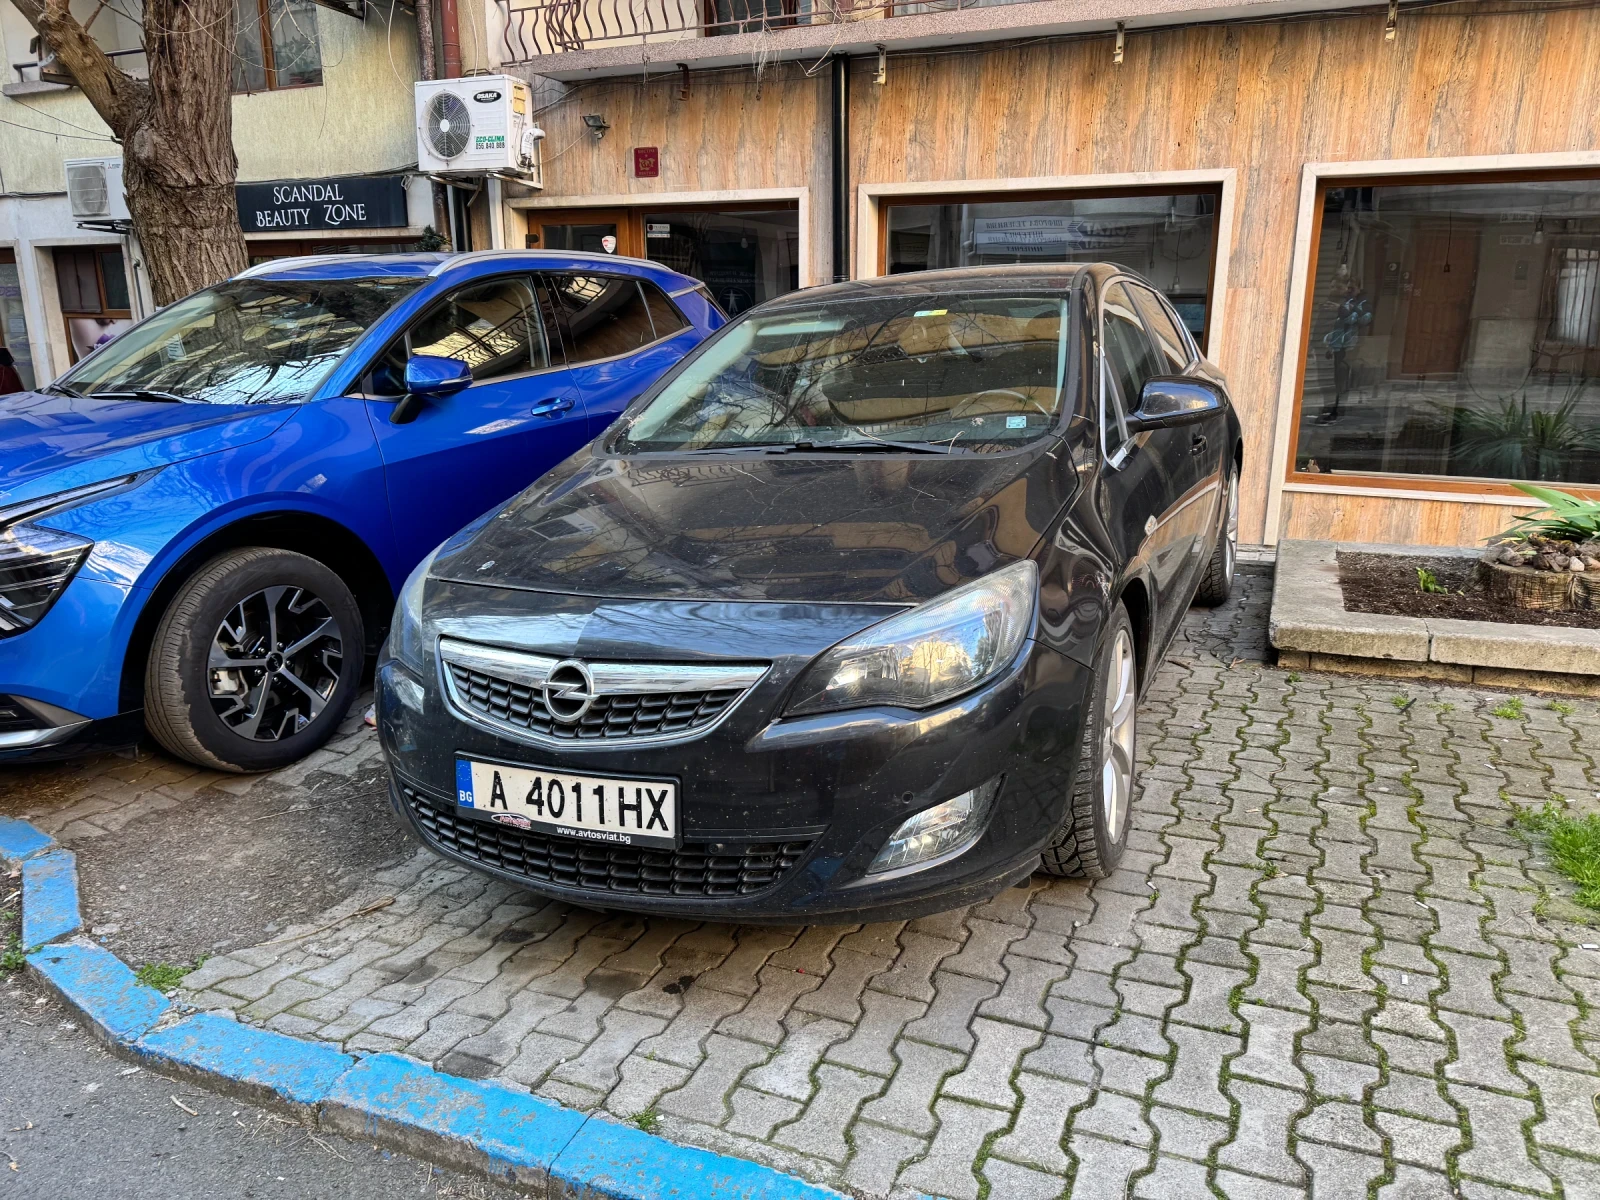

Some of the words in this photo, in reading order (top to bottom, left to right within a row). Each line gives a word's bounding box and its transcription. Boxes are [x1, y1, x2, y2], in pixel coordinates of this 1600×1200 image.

[475, 135, 505, 143] ECO-CLIMA
[273, 183, 344, 205] SCANDAL
[255, 208, 311, 227] BEAUTY
[323, 203, 367, 225] ZONE
[459, 790, 473, 803] BG
[490, 770, 508, 810] A
[556, 825, 631, 845] www.avtosviat.bg
